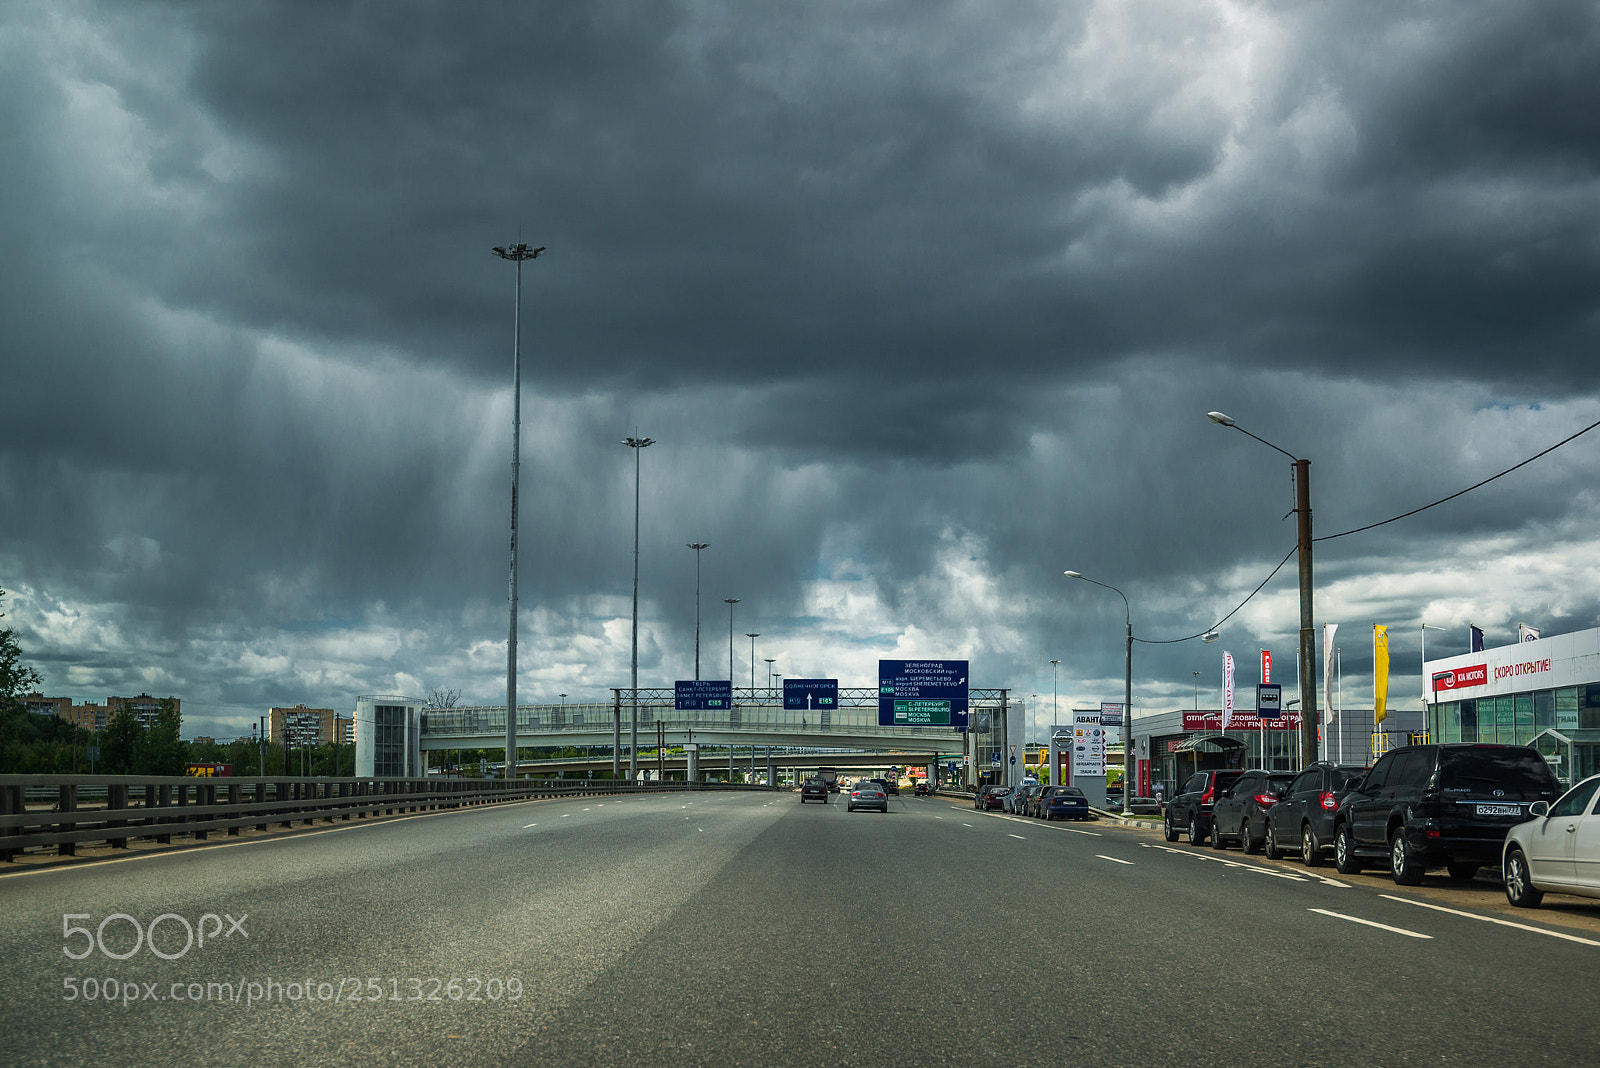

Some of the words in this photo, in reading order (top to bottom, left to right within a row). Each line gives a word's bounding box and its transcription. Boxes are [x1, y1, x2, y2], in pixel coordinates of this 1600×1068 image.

[1457, 673, 1466, 682] KIA
[1465, 669, 1485, 681] MOTORS
[1494, 665, 1514, 680] СКОРО
[1514, 658, 1551, 677] ОТКРЫТИЕ!
